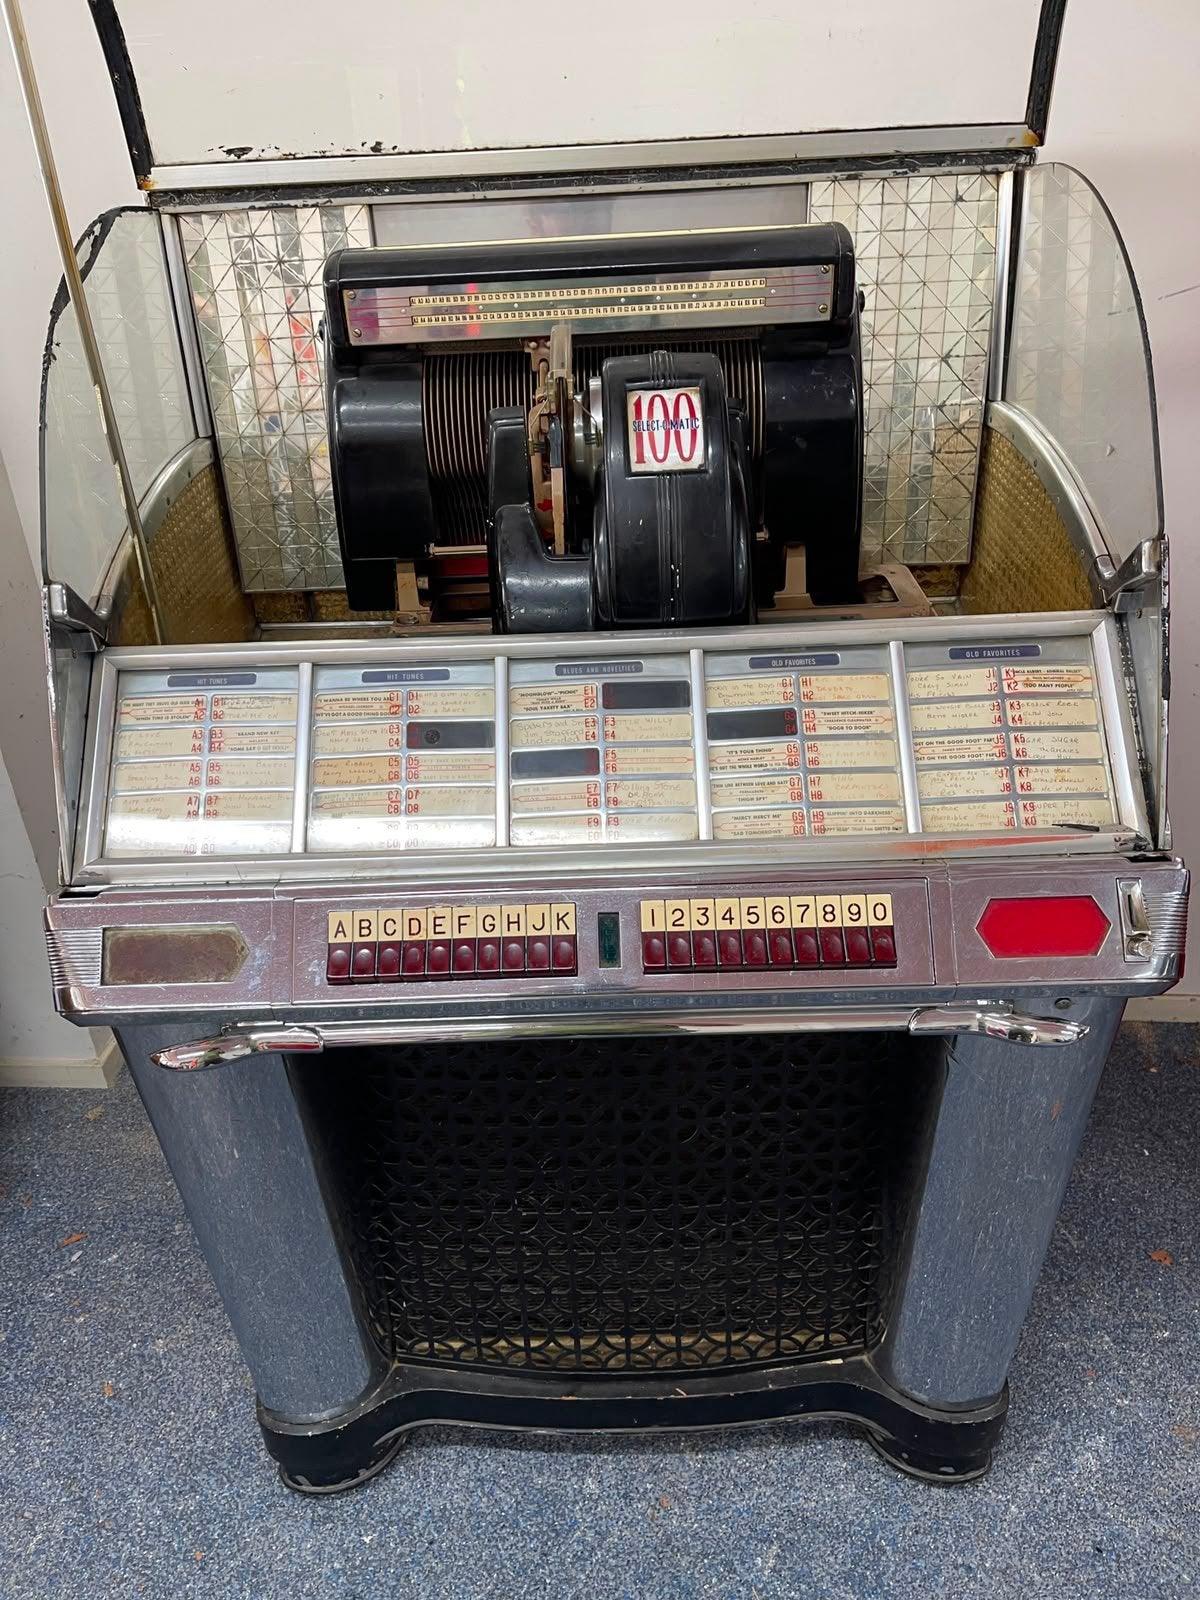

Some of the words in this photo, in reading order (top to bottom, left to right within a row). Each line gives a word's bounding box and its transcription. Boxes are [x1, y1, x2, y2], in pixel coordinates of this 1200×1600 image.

[632, 418, 700, 432] SELECT-O-MATIC
[966, 650, 981, 658] OLD
[785, 658, 816, 666] FAVORITES
[563, 666, 582, 674] BLUES
[602, 664, 636, 672] NOVELTIES
[986, 670, 996, 678] J1
[782, 678, 792, 688] G1
[802, 678, 812, 687] H1
[988, 682, 998, 692] J2
[1007, 682, 1018, 691] K2
[584, 686, 594, 695] E1
[802, 690, 814, 700] H2
[408, 692, 419, 701] D1
[783, 692, 794, 700] G2
[584, 699, 595, 708] E2
[990, 702, 1000, 711] J3
[1010, 700, 1021, 710] K3
[409, 704, 420, 714] D2
[194, 710, 204, 720] A2
[213, 710, 224, 720] B2
[804, 710, 816, 720] H3
[992, 714, 1002, 724] J4
[1012, 714, 1023, 724] K4
[585, 718, 596, 728] E3
[604, 717, 616, 726] F3
[389, 724, 400, 734] C3
[805, 723, 816, 733] H4
[192, 730, 202, 740] A3
[211, 730, 222, 739] B3
[586, 731, 596, 740] E4
[604, 730, 616, 740] F4
[994, 734, 1006, 744] J5
[1014, 734, 1026, 744] K5
[191, 743, 202, 752] A4
[389, 738, 400, 747] C4
[806, 743, 818, 752] H5
[787, 744, 798, 754] G5
[996, 748, 1007, 758] J6
[1016, 748, 1028, 758] K6
[606, 750, 617, 759] F5
[388, 758, 400, 767] C5
[408, 756, 420, 766] D5
[808, 756, 820, 766] H6
[190, 762, 200, 772] A5
[209, 762, 220, 772] B5
[606, 763, 617, 772] F6
[388, 771, 400, 780] C6
[408, 770, 420, 780] D6
[998, 768, 1008, 778] J7
[1018, 768, 1030, 778] K7
[189, 776, 200, 786] A6
[208, 776, 220, 786] B6
[790, 777, 801, 787] G7
[810, 776, 821, 786] H7
[586, 784, 598, 794] E7
[606, 783, 618, 792] F7
[1000, 782, 1012, 792] J8
[1020, 782, 1032, 792] K8
[388, 790, 400, 800] C7
[790, 791, 802, 801] G8
[810, 790, 822, 800] H8
[187, 796, 198, 806] A7
[207, 796, 218, 805] B7
[587, 798, 598, 807] E8
[607, 796, 618, 806] F8
[388, 804, 400, 814] C8
[408, 804, 420, 813] D8
[1002, 802, 1014, 813] J9
[1023, 802, 1035, 812] K9
[206, 809, 218, 818] B8
[792, 812, 804, 821] G9
[812, 810, 824, 820] H9
[588, 818, 599, 827] E9
[608, 816, 619, 826] F9
[1004, 817, 1016, 827] J0
[1024, 816, 1037, 826] K0
[793, 826, 805, 835] G0
[650, 908, 655, 926] 1
[672, 908, 684, 926] 2
[696, 907, 709, 926] 3
[722, 907, 734, 925] 4
[747, 906, 760, 924] 5
[772, 905, 785, 924] 6
[796, 904, 810, 922] 7
[822, 904, 836, 922] 8
[848, 903, 862, 922] 9
[873, 902, 886, 921] 0
[334, 922, 346, 938] A
[358, 919, 372, 936] B
[384, 918, 396, 936] C
[408, 918, 421, 936] D
[433, 916, 446, 934] E
[458, 915, 470, 934] F
[482, 914, 496, 932] G
[507, 913, 520, 932] H
[532, 912, 545, 930] J
[556, 912, 570, 930] K
